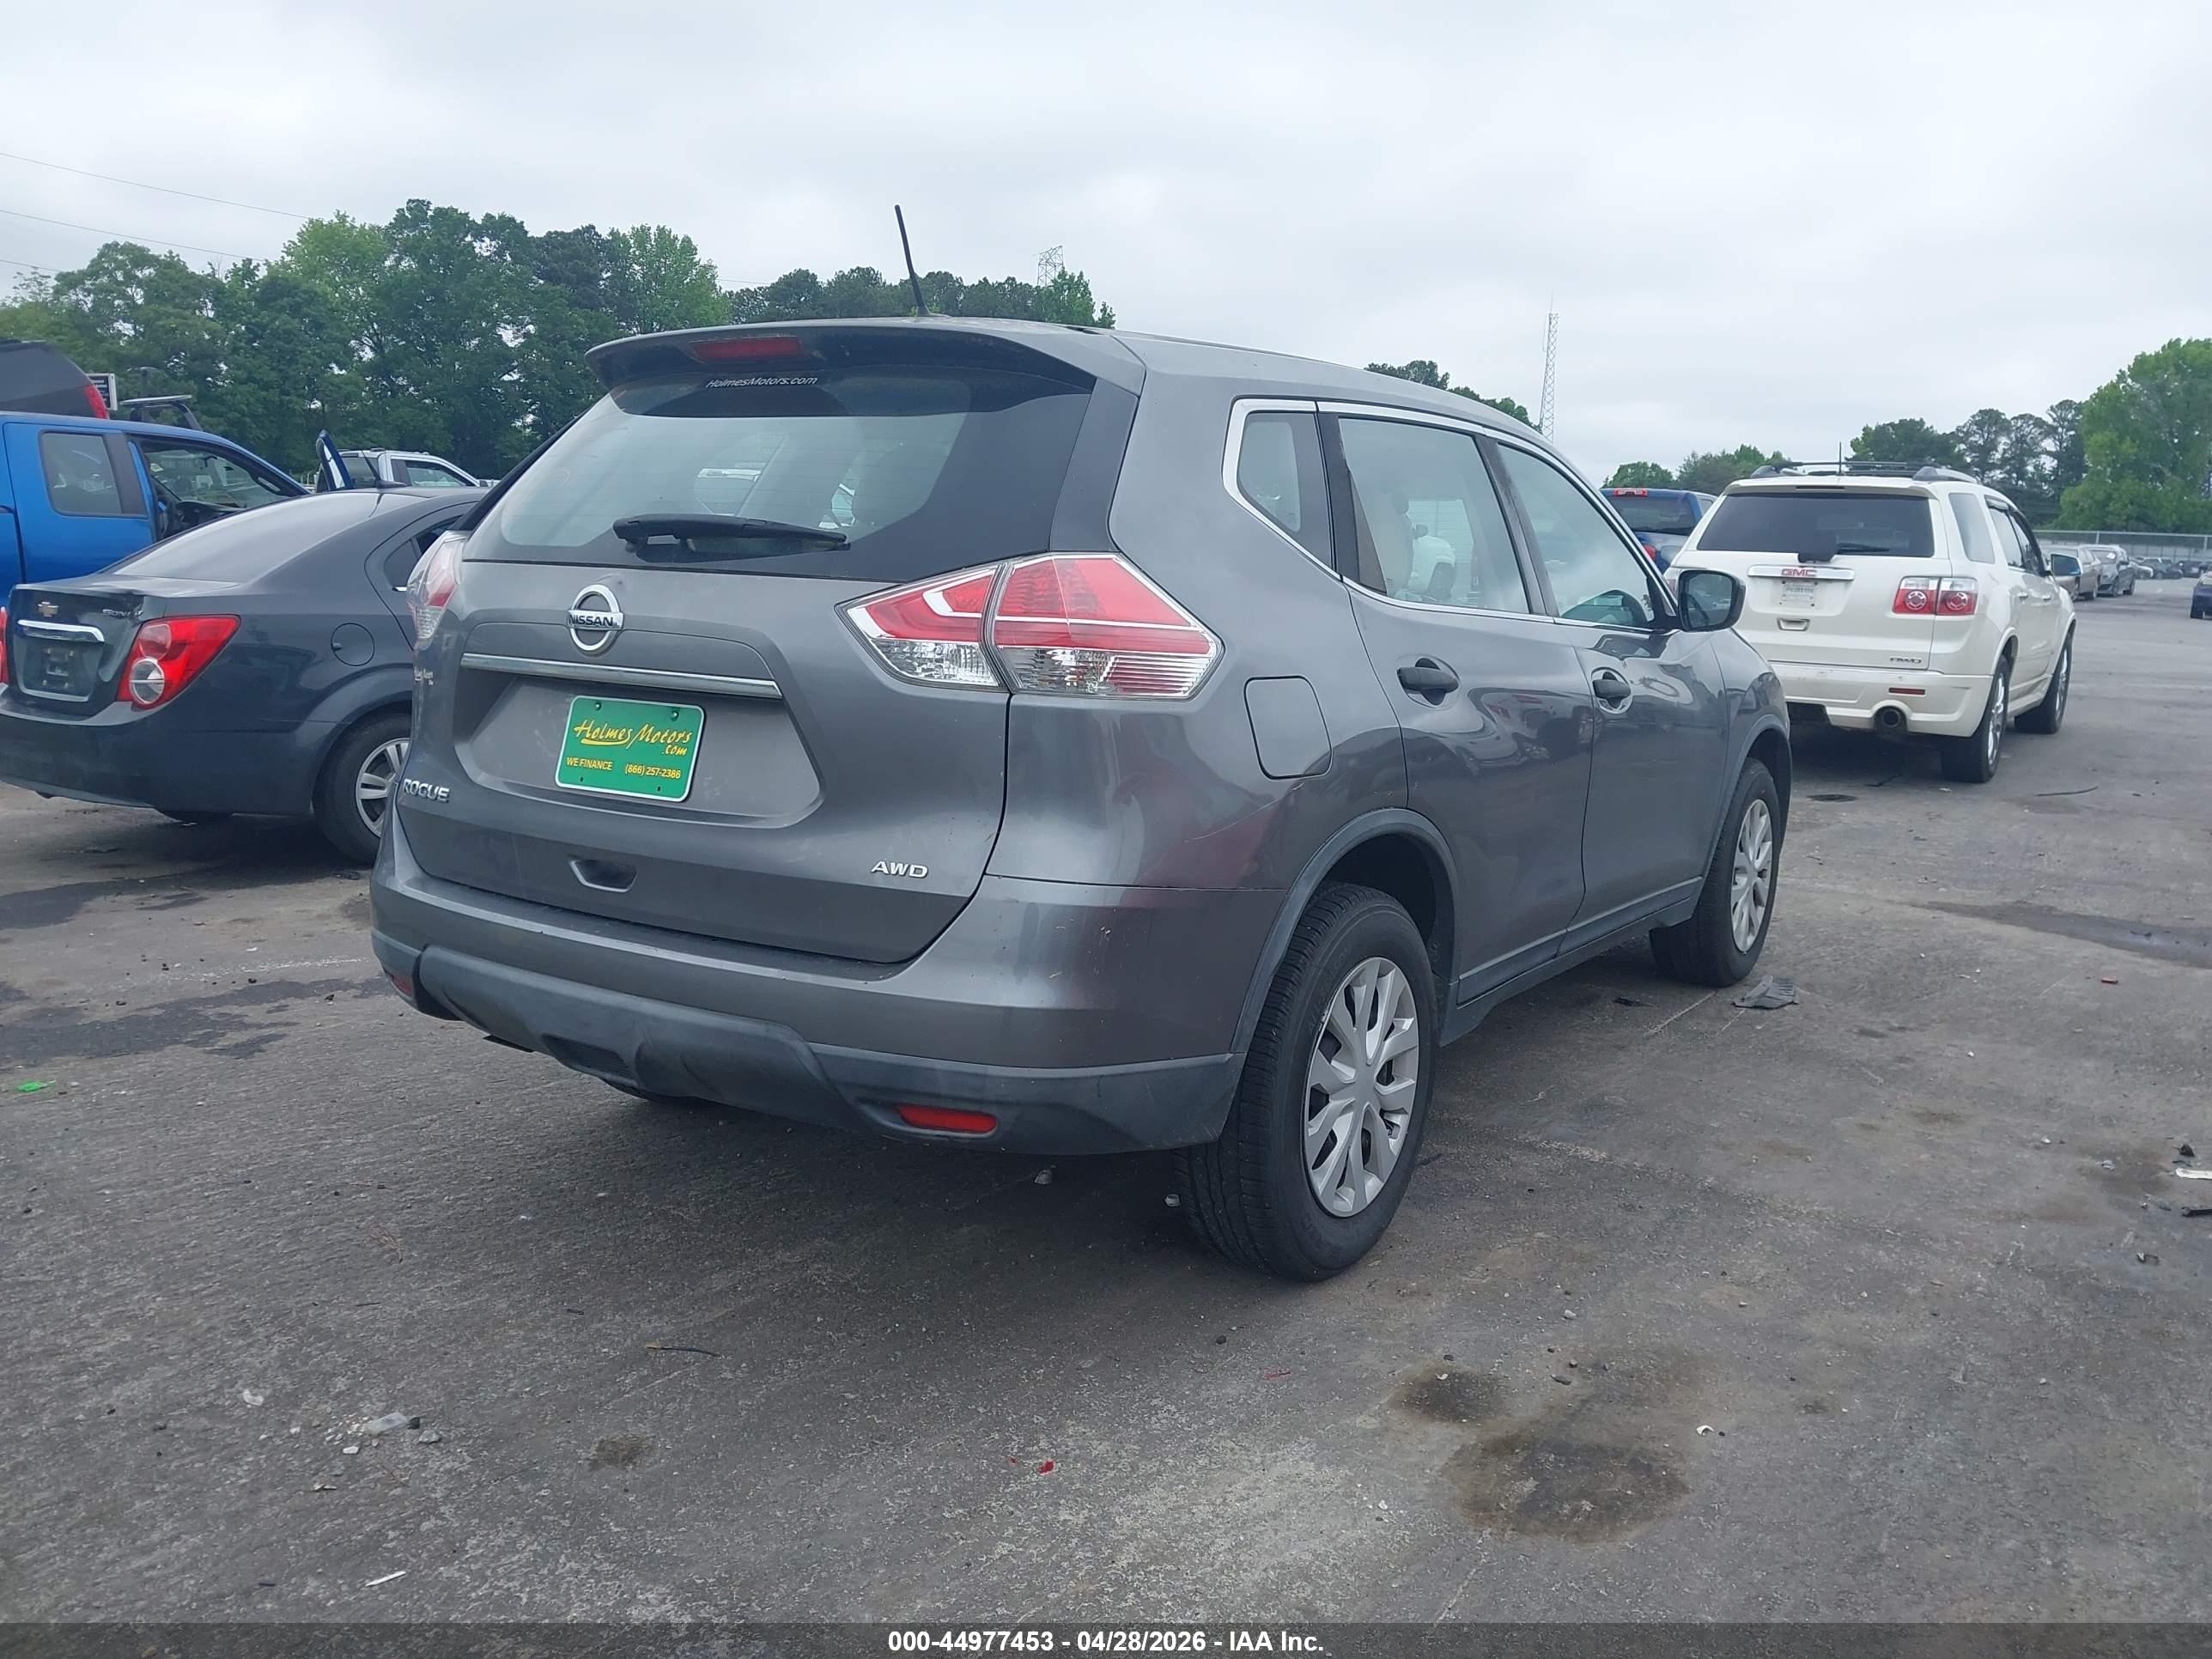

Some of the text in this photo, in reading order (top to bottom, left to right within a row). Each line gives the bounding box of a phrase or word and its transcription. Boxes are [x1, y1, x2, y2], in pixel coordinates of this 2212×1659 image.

[705, 375, 818, 388] HolmesMotors.com
[1781, 568, 1818, 578] GMC
[568, 613, 614, 627] NISSAN
[573, 719, 633, 745] Holmes
[566, 757, 682, 779] WE FINANCE (866) 257-2386
[402, 778, 450, 803] ROGUE
[870, 860, 929, 879] AWD
